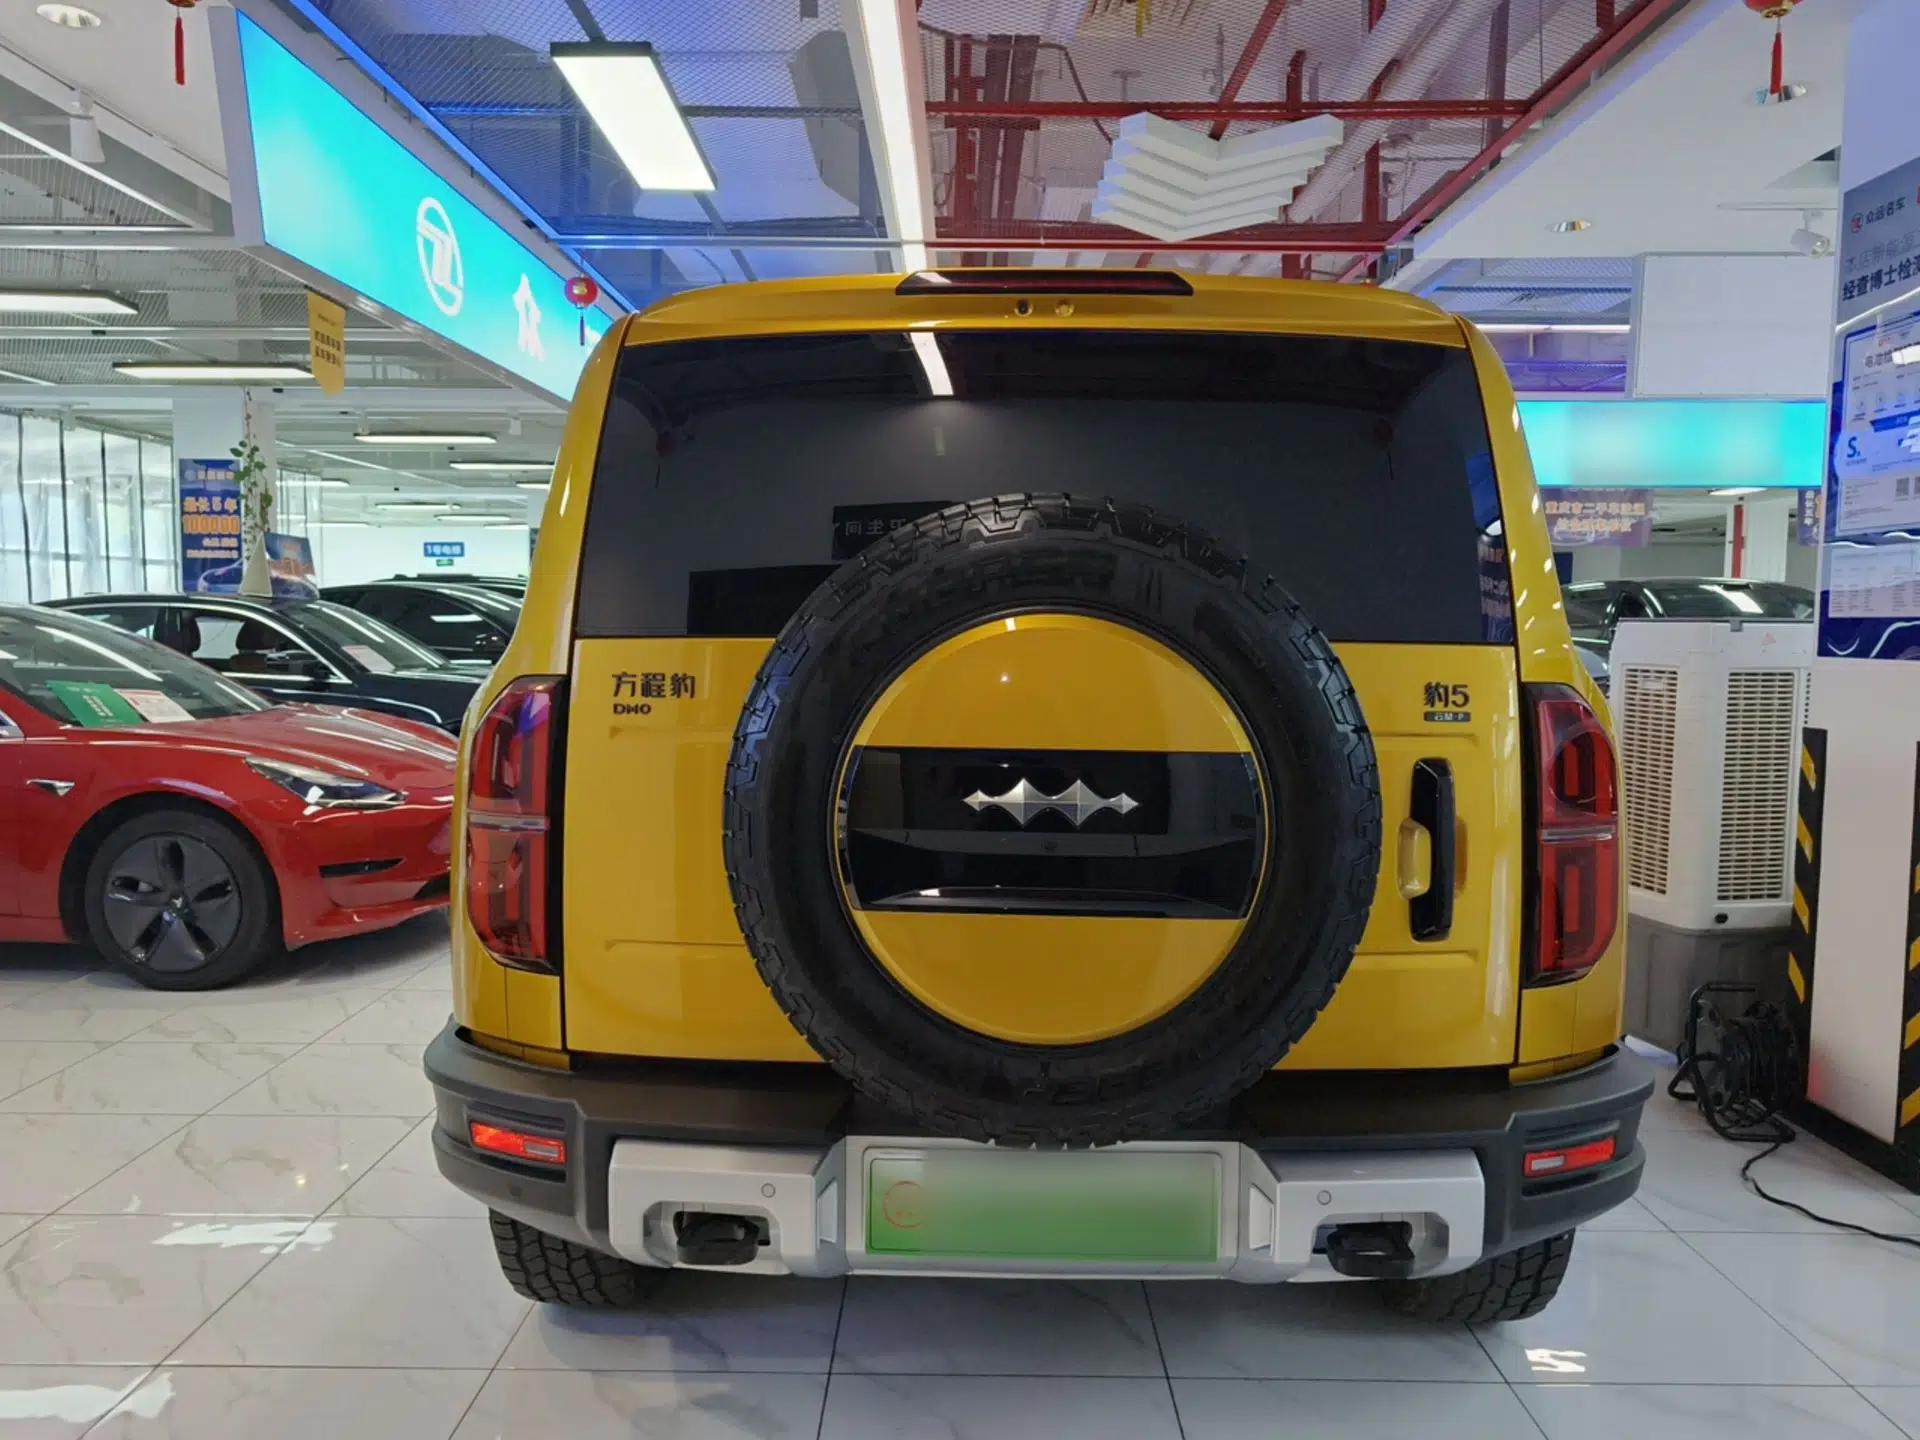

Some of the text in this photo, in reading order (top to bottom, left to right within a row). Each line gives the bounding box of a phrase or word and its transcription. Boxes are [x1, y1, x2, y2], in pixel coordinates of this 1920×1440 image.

[612, 671, 695, 698] 方程豹
[1424, 681, 1470, 708] 豹5
